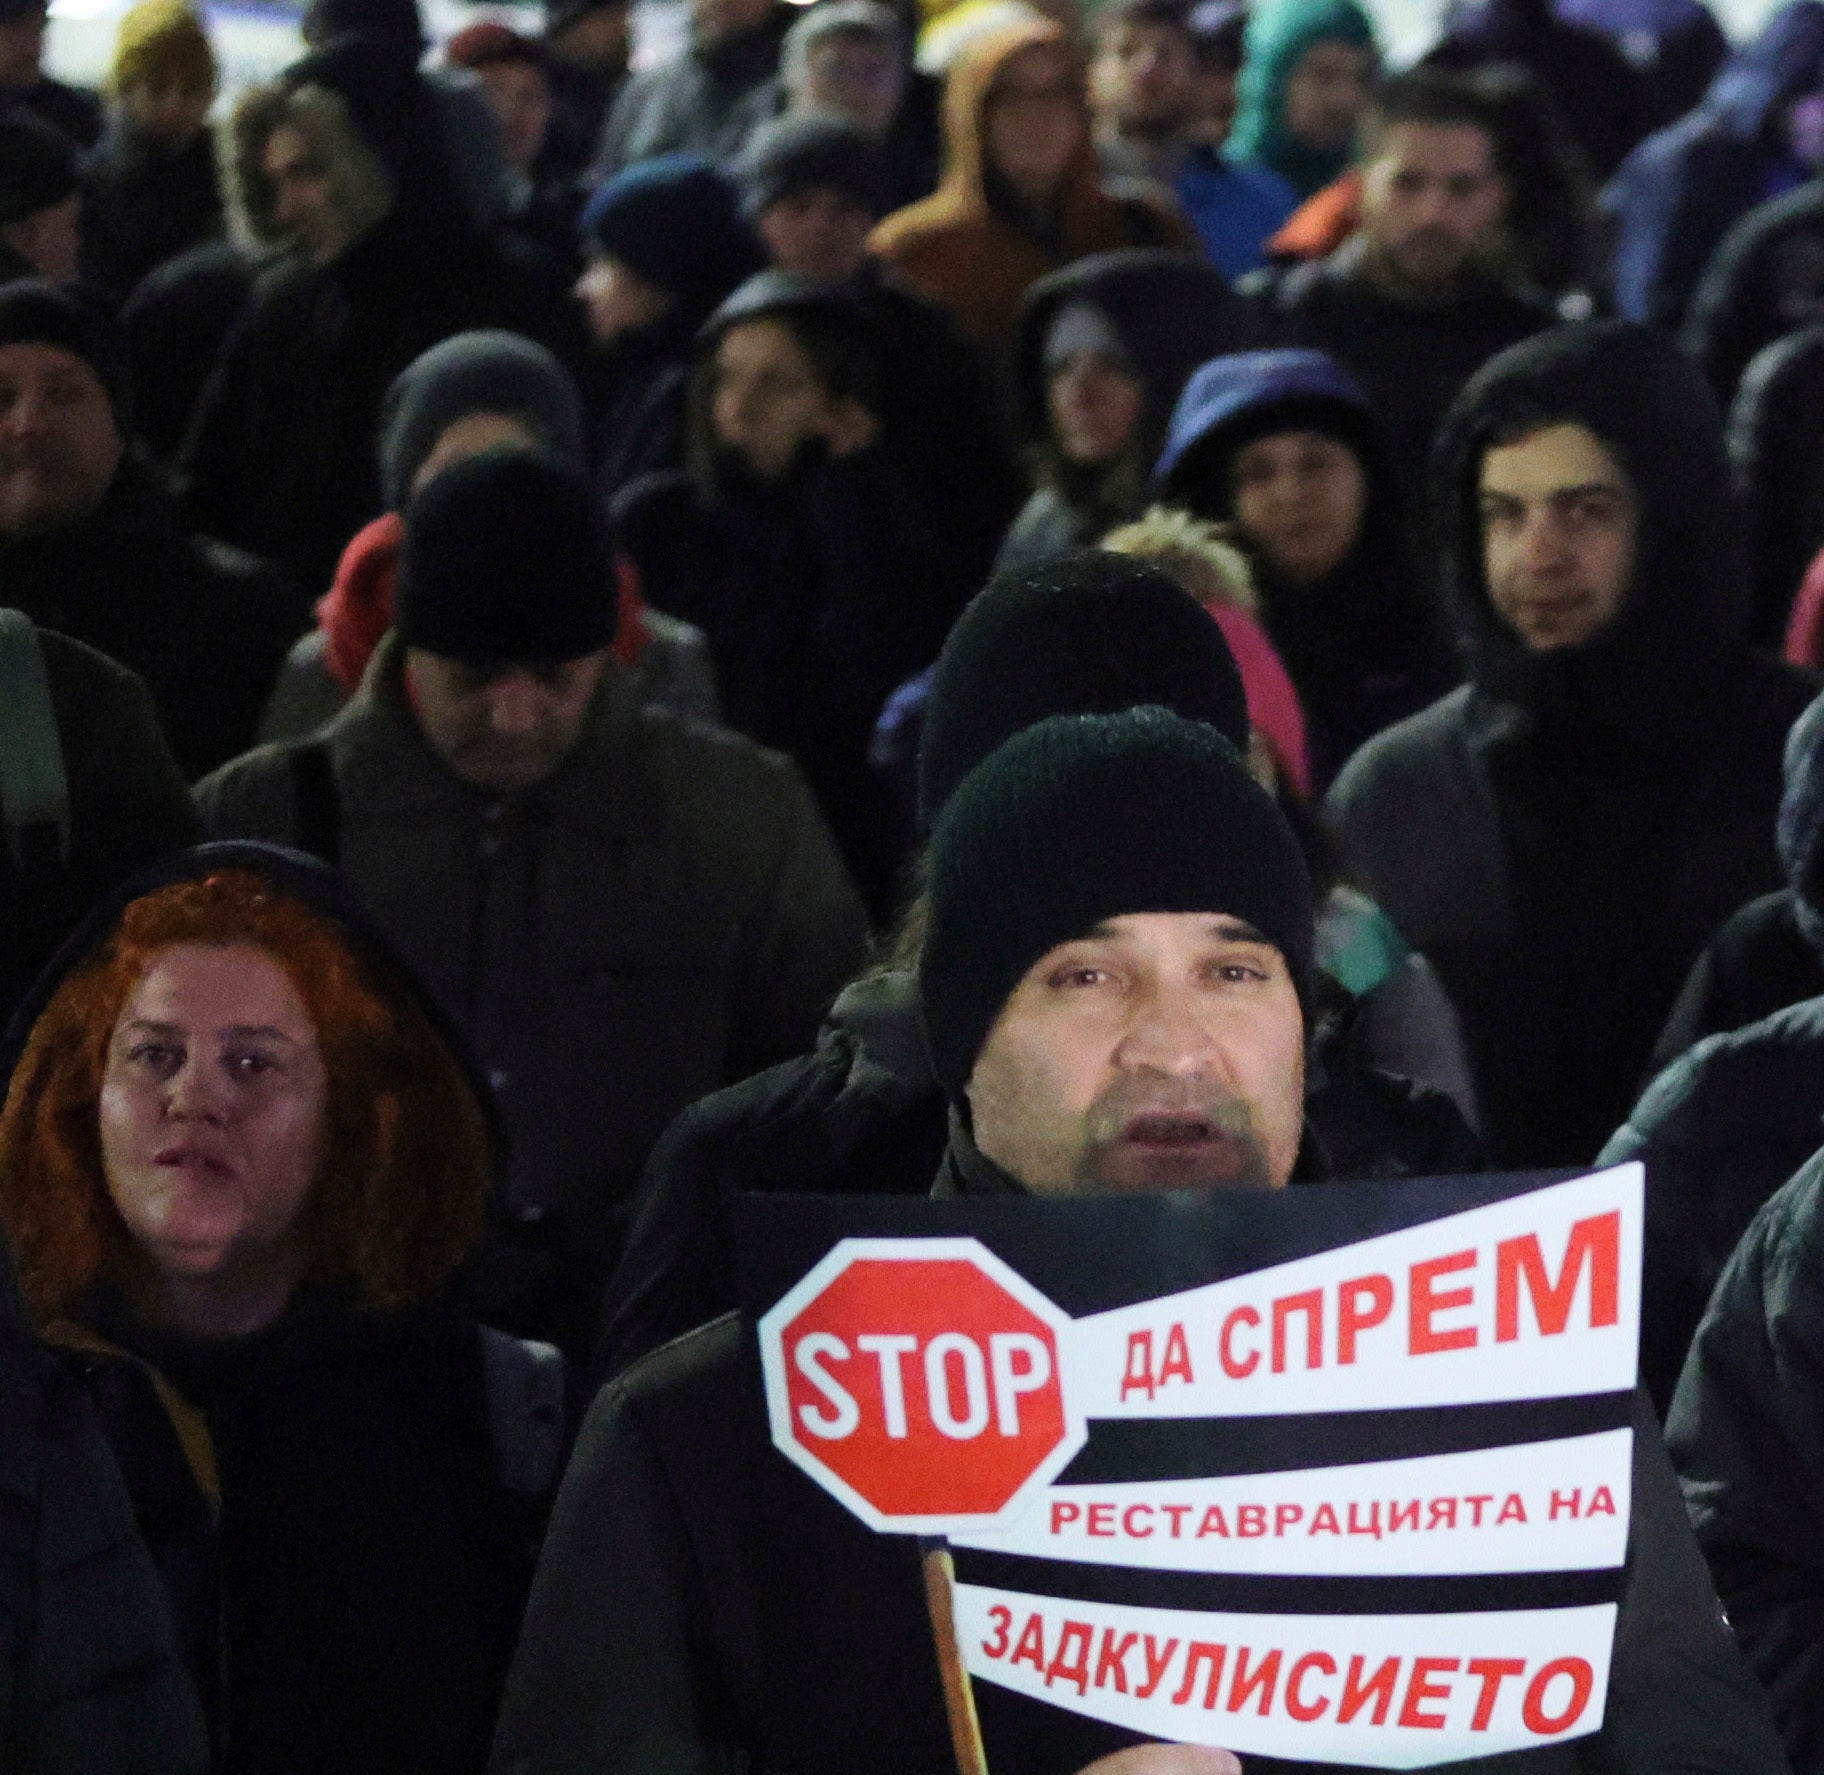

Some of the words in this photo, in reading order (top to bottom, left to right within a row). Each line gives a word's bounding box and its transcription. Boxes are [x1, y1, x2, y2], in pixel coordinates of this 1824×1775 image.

[1120, 1325, 1194, 1402] ДА
[1219, 1209, 1622, 1380] СПРЕМ
[795, 1332, 1052, 1439] STOP
[1049, 1494, 1528, 1542] РЕСТАВРАЦИЯТА
[1549, 1484, 1616, 1520] НА
[981, 1604, 1593, 1734] ЗАДКУЛИСИЕТО
